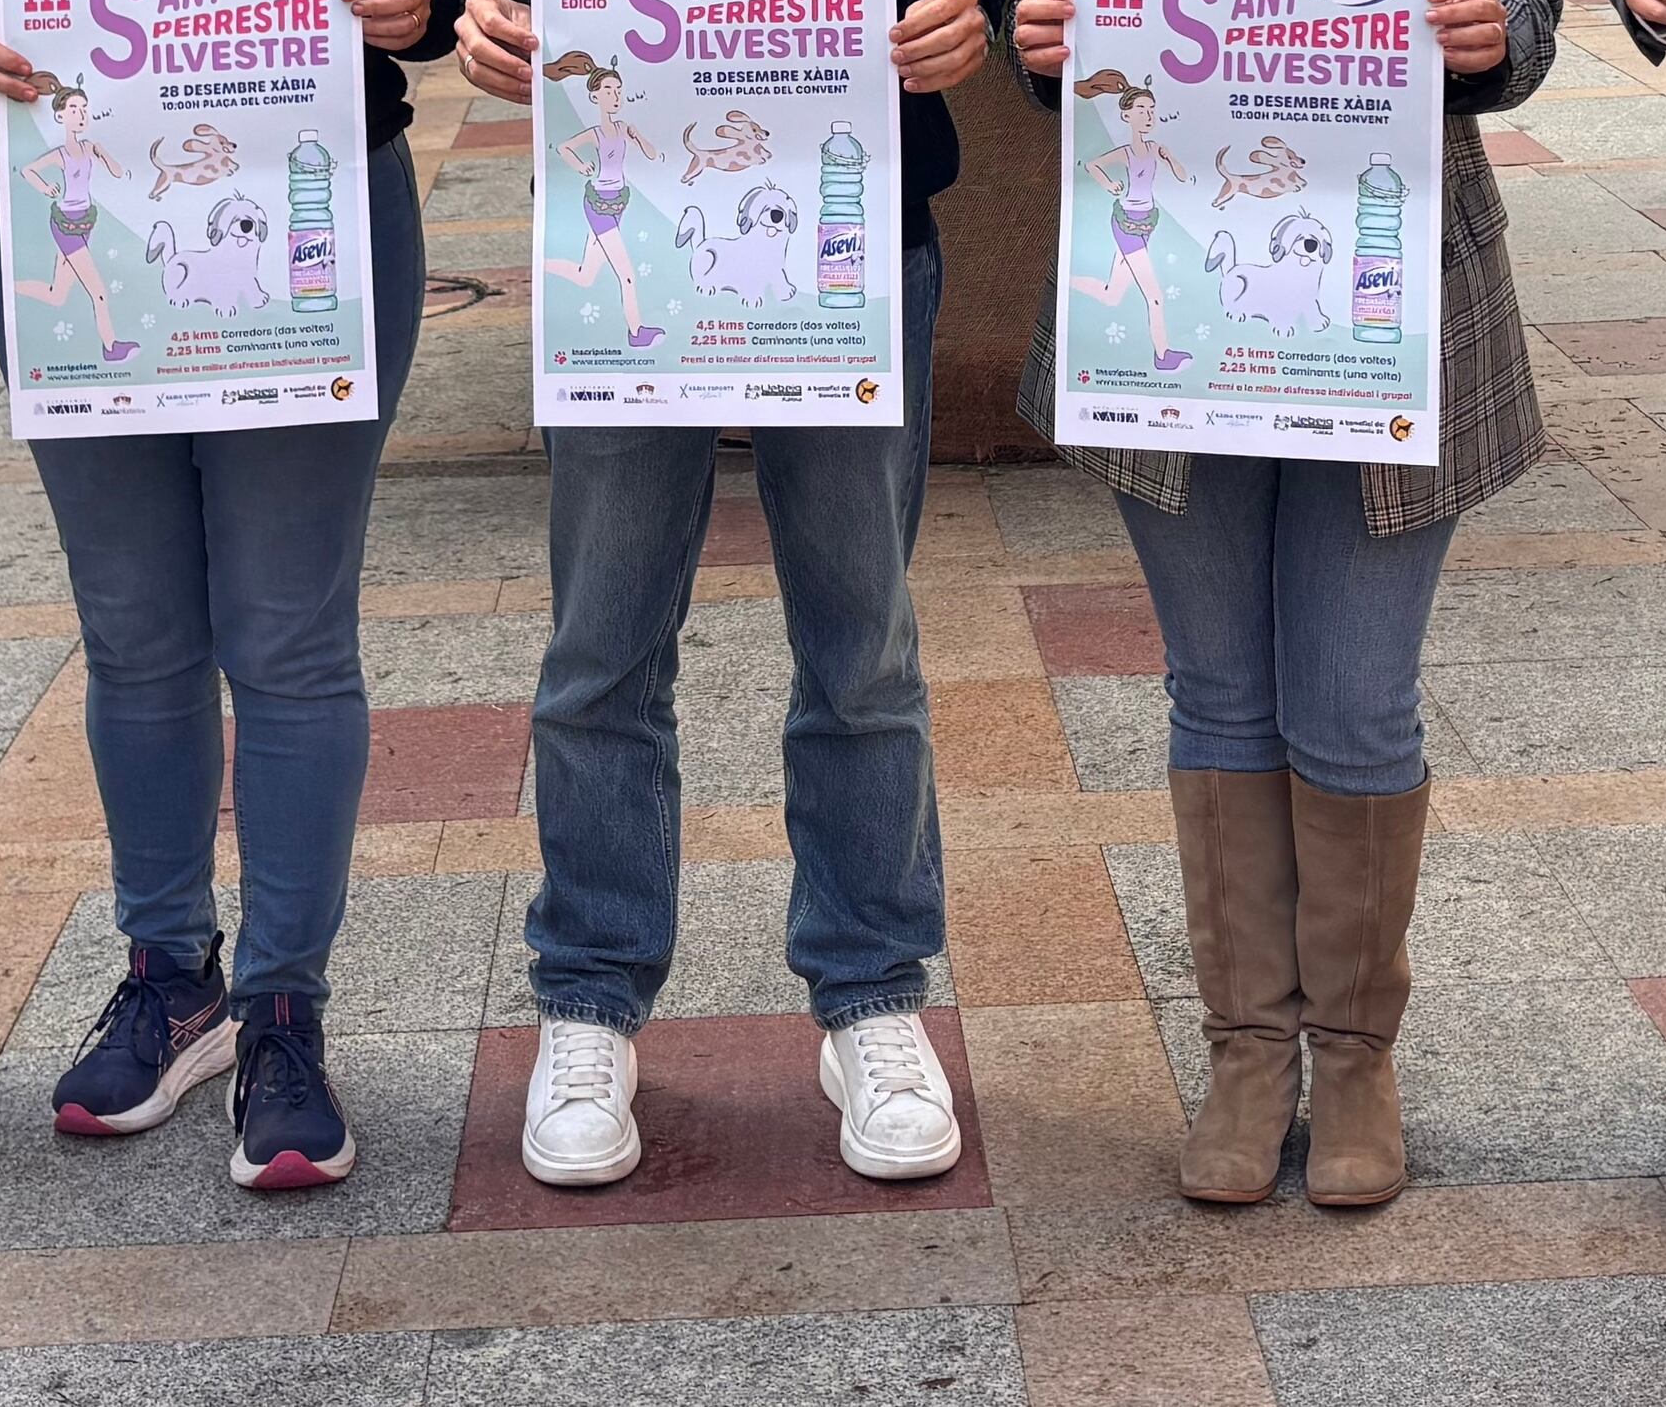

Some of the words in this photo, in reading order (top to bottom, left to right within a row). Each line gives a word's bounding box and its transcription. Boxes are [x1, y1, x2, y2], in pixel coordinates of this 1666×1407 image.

[23, 13, 71, 30] EDICIÓ
[1095, 11, 1142, 27] EDICIÓ
[1224, 5, 1410, 51] PERRESTRE
[692, 71, 712, 82] 28
[717, 70, 798, 82] DESEMBRE
[803, 66, 849, 80] XÀBIA
[159, 85, 179, 97] 28
[184, 80, 266, 96] DESEMBRE
[269, 74, 316, 91] XÀBIA
[695, 86, 732, 95] 10:00H
[736, 86, 770, 95] PLAÇA
[773, 85, 792, 94] DEL
[795, 85, 848, 93] CONVENT
[162, 99, 199, 110] 10:00H
[202, 97, 237, 108] PLAÇA
[240, 96, 259, 106] DEL
[262, 93, 315, 105] CONVENT
[1229, 94, 1248, 106] 28
[1254, 94, 1339, 109] DESEMBRE
[1343, 94, 1392, 111] XÀBIA
[1231, 110, 1269, 120] 10:00H
[1272, 111, 1308, 122] PLAÇA
[1312, 112, 1331, 122] DEL
[1335, 113, 1389, 124] CONVENT
[291, 237, 327, 264] Asevi
[820, 232, 856, 258] Asevi
[1355, 264, 1394, 292] Asevi
[696, 320, 714, 330] 4,5
[718, 320, 743, 329] kms
[747, 320, 797, 330] Corredors
[170, 331, 189, 342] 4,5
[192, 329, 218, 340] kms
[221, 326, 271, 338] Corredors
[691, 335, 717, 345] 2,25
[720, 335, 746, 344] kms
[166, 345, 192, 357] 2,25
[195, 343, 221, 354] kms
[1225, 347, 1244, 358] 4,5
[1248, 348, 1274, 358] kms
[1278, 350, 1329, 362] Corredors
[1219, 361, 1246, 373] 2,25
[1250, 363, 1276, 374] kms
